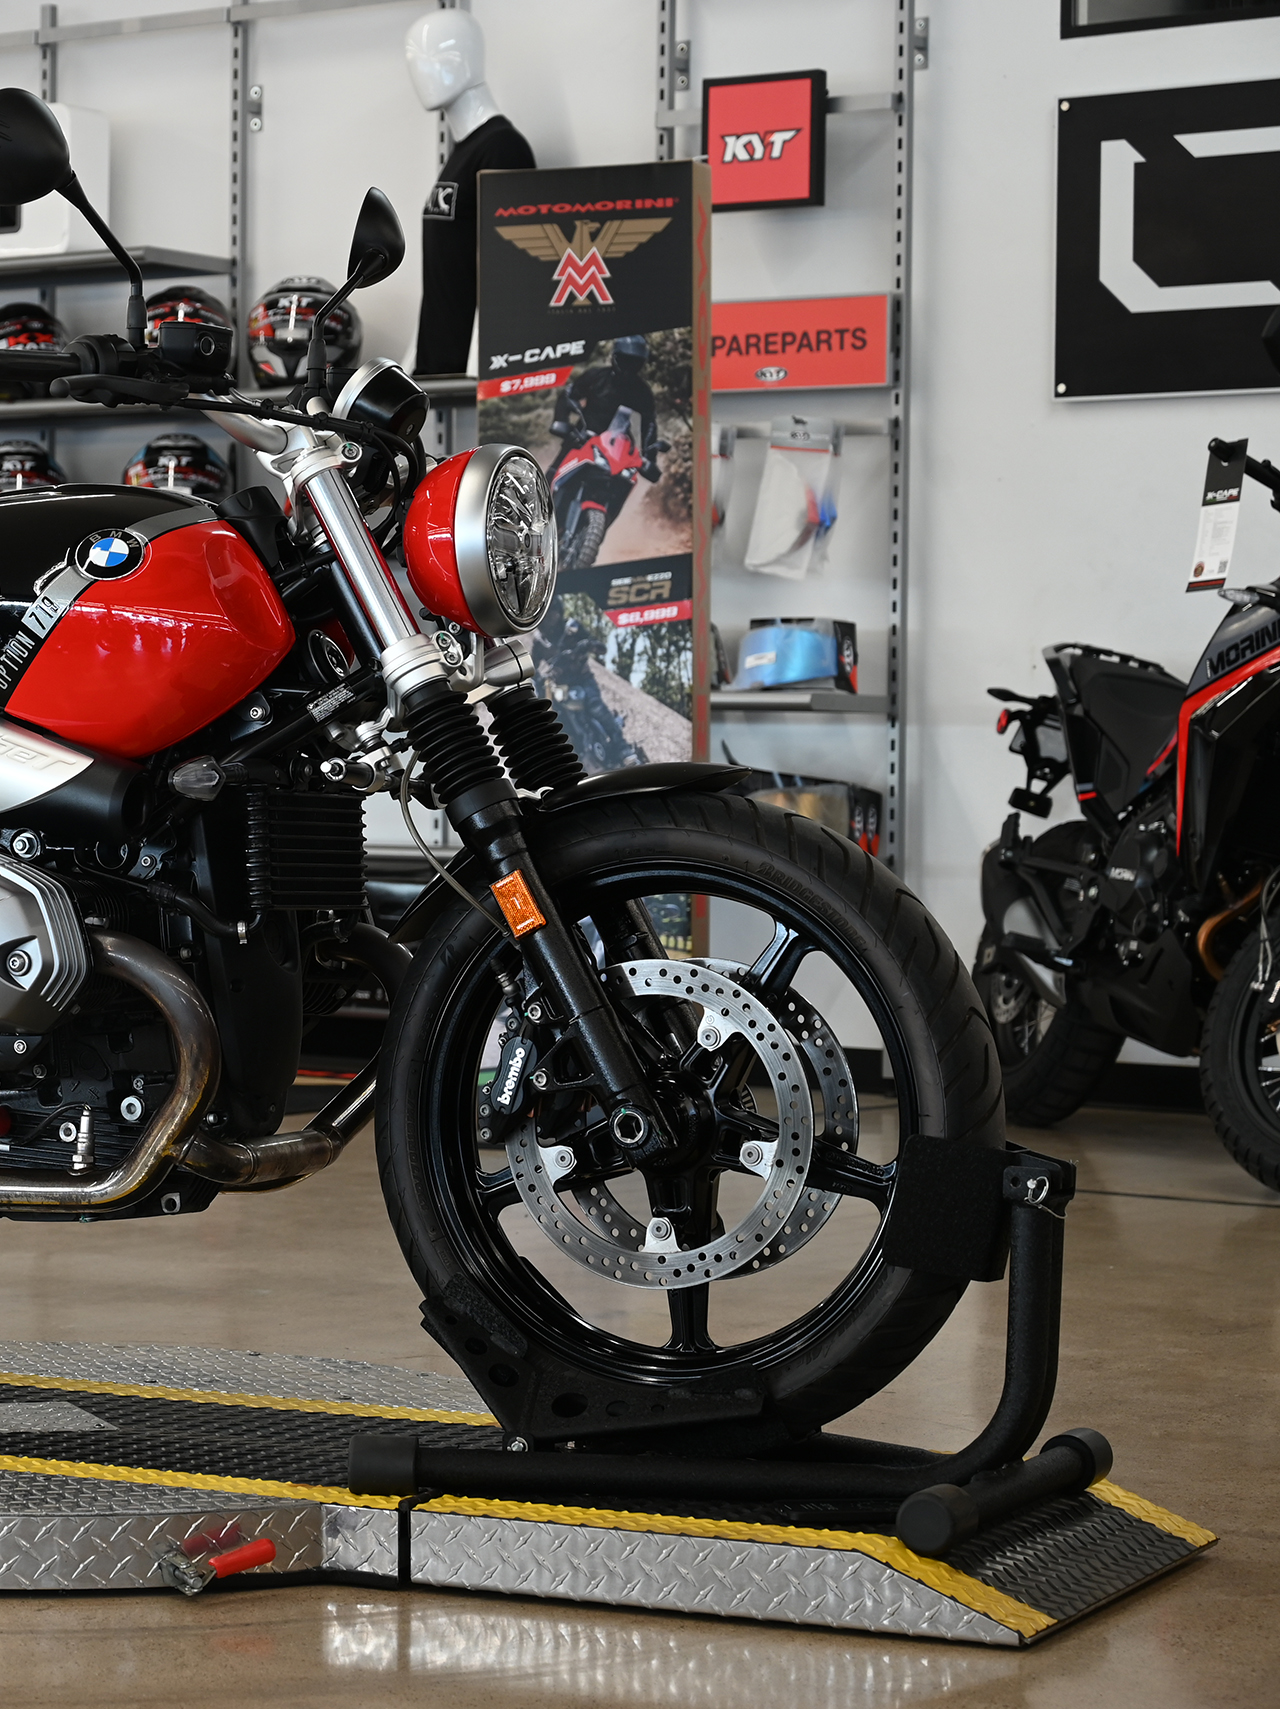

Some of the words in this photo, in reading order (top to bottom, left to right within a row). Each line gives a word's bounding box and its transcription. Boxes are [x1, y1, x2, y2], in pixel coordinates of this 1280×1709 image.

[720, 128, 802, 163] KYT
[494, 197, 674, 217] MOTOMORINI
[488, 339, 586, 371] X-CAPE
[711, 327, 868, 357] PAREPARTS
[500, 372, 557, 393] $7,999
[89, 530, 139, 548] BMW
[28, 596, 59, 630] 719
[496, 1047, 526, 1106] brembo
